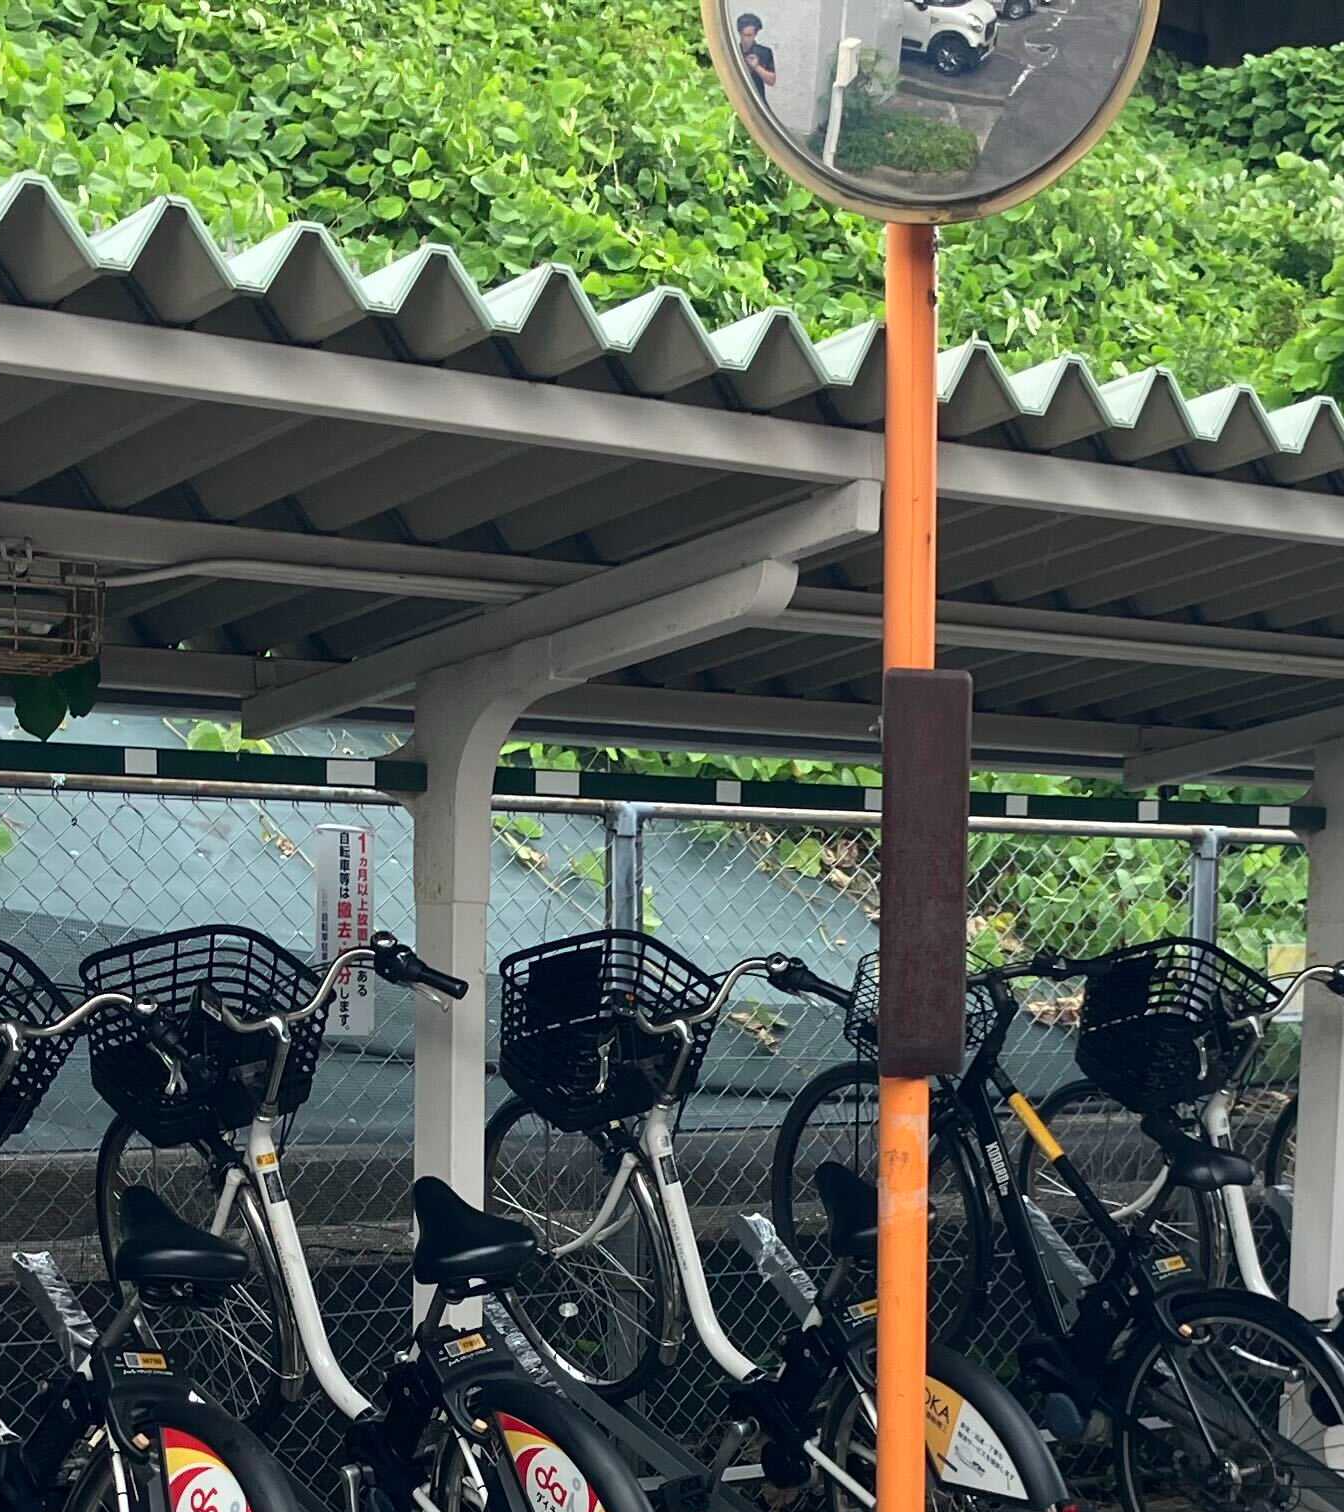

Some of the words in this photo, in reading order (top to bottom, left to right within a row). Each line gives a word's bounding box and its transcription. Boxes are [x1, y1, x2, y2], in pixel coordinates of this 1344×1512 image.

[337, 831, 352, 1031] 自転車等は撤去・分します。
